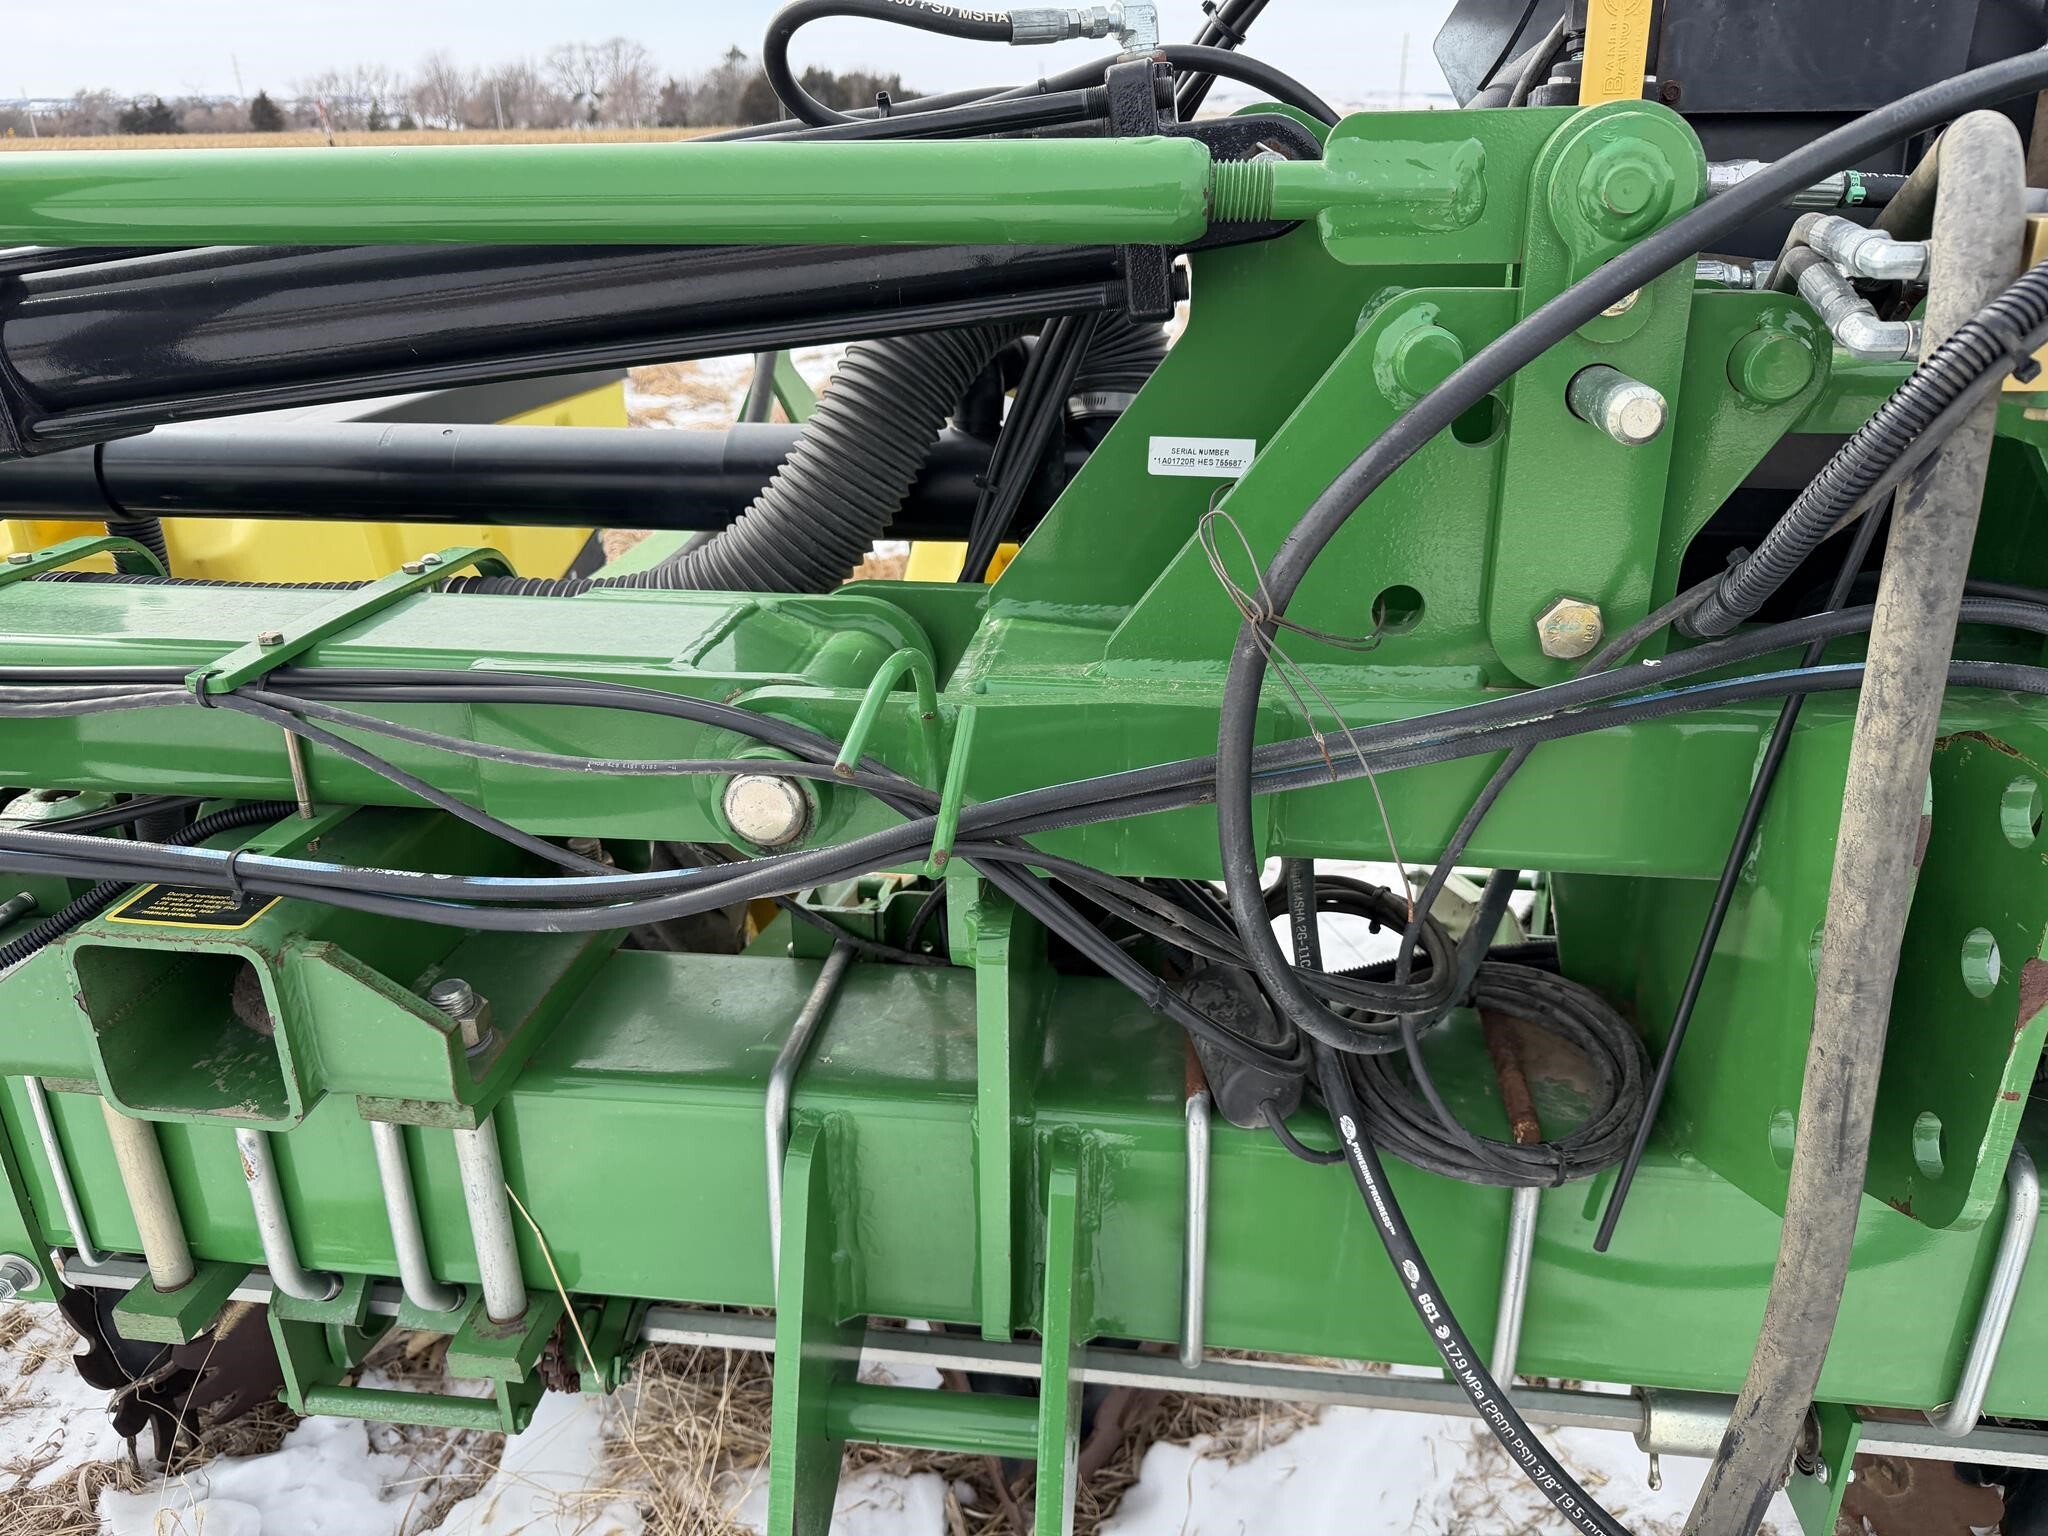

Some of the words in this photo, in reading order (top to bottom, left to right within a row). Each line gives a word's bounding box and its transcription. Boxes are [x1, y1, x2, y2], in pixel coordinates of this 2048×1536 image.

[958, 9, 1009, 23] MSHA
[1171, 447, 1196, 456] SERIAL
[1198, 448, 1230, 456] NUMBER
[1293, 892, 1306, 923] MSHA
[1351, 1141, 1375, 1186] POWERING
[1443, 1340, 1468, 1370] 17.9
[1461, 1369, 1485, 1399] MPa
